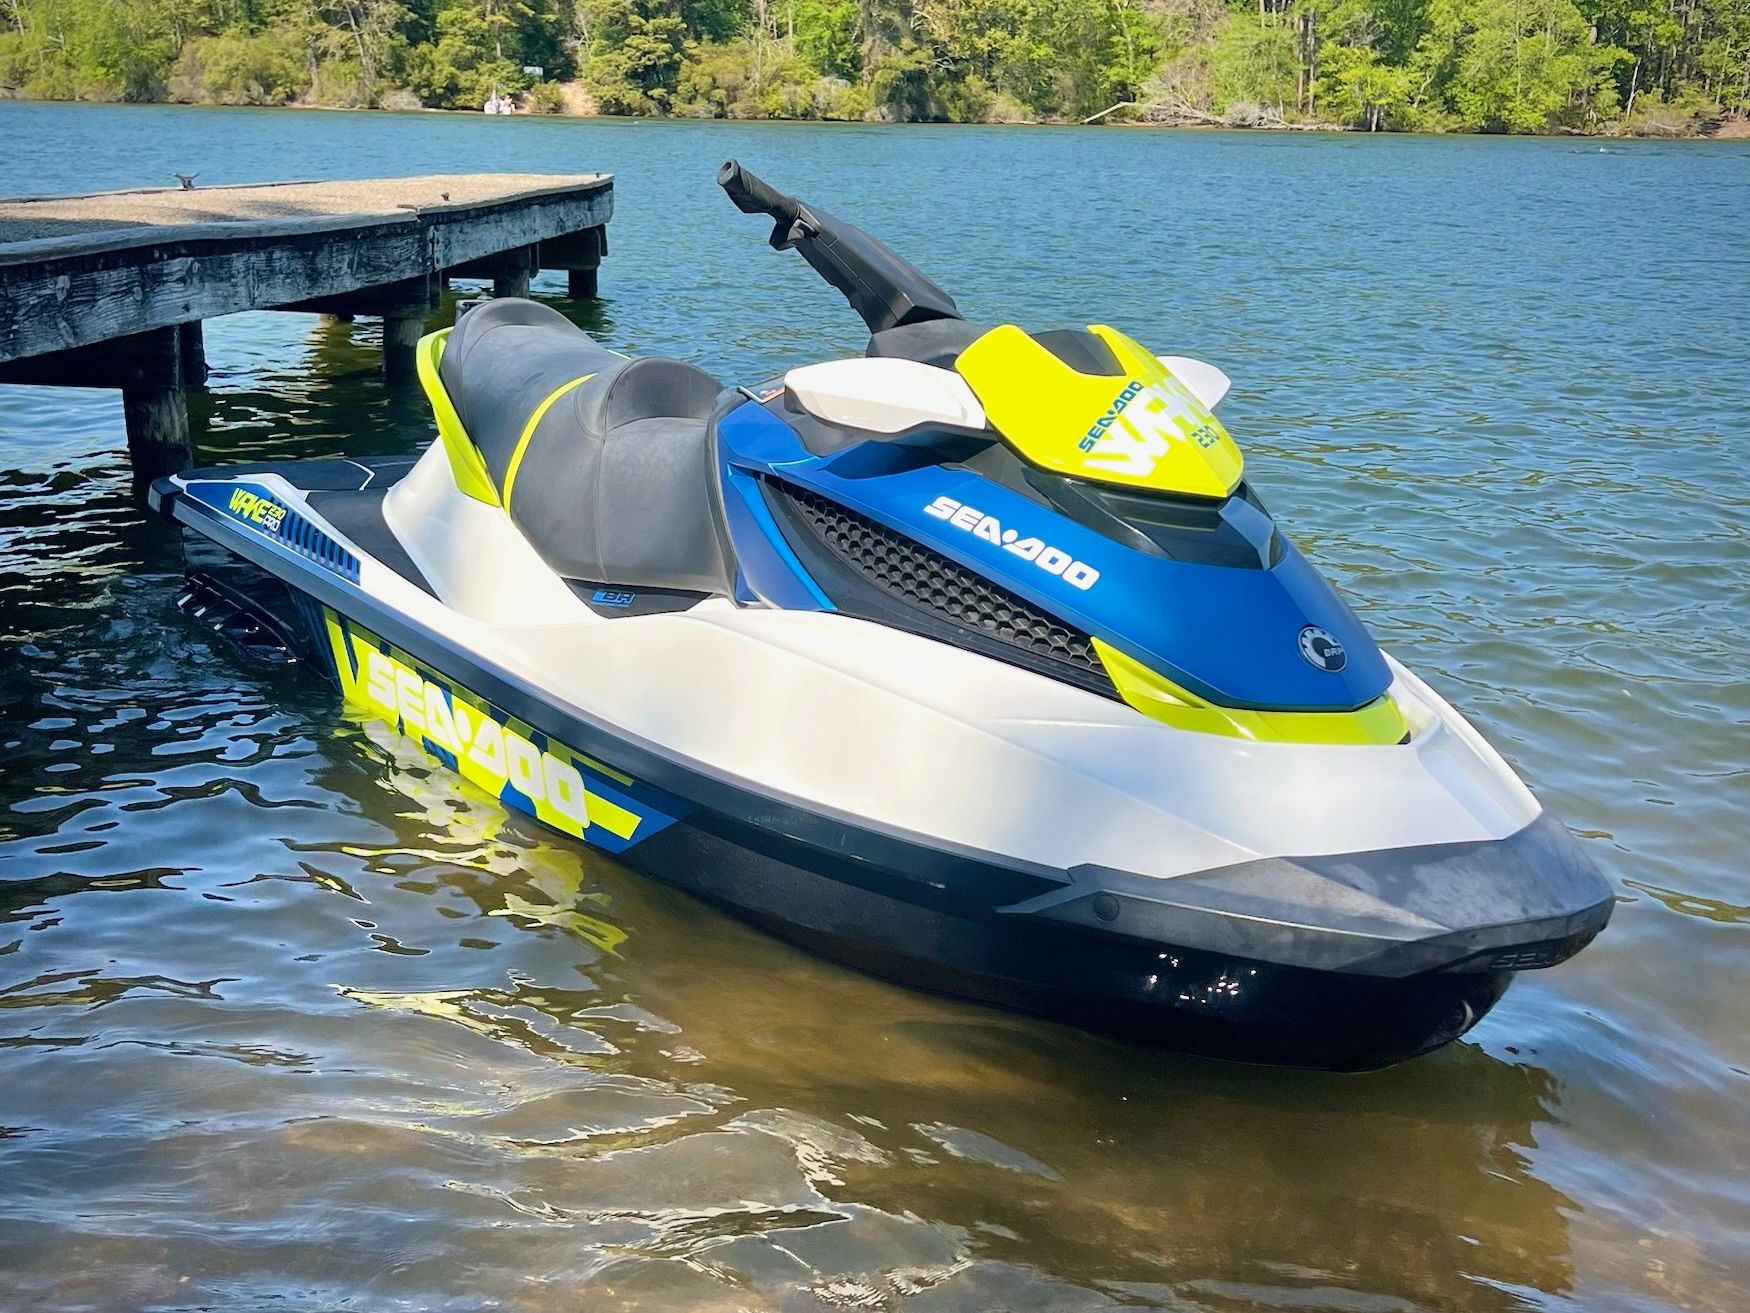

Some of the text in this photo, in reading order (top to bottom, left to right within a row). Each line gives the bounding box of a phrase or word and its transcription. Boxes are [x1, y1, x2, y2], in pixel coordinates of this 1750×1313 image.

[229, 487, 287, 524] WAKE 230
[262, 517, 282, 532] PRO
